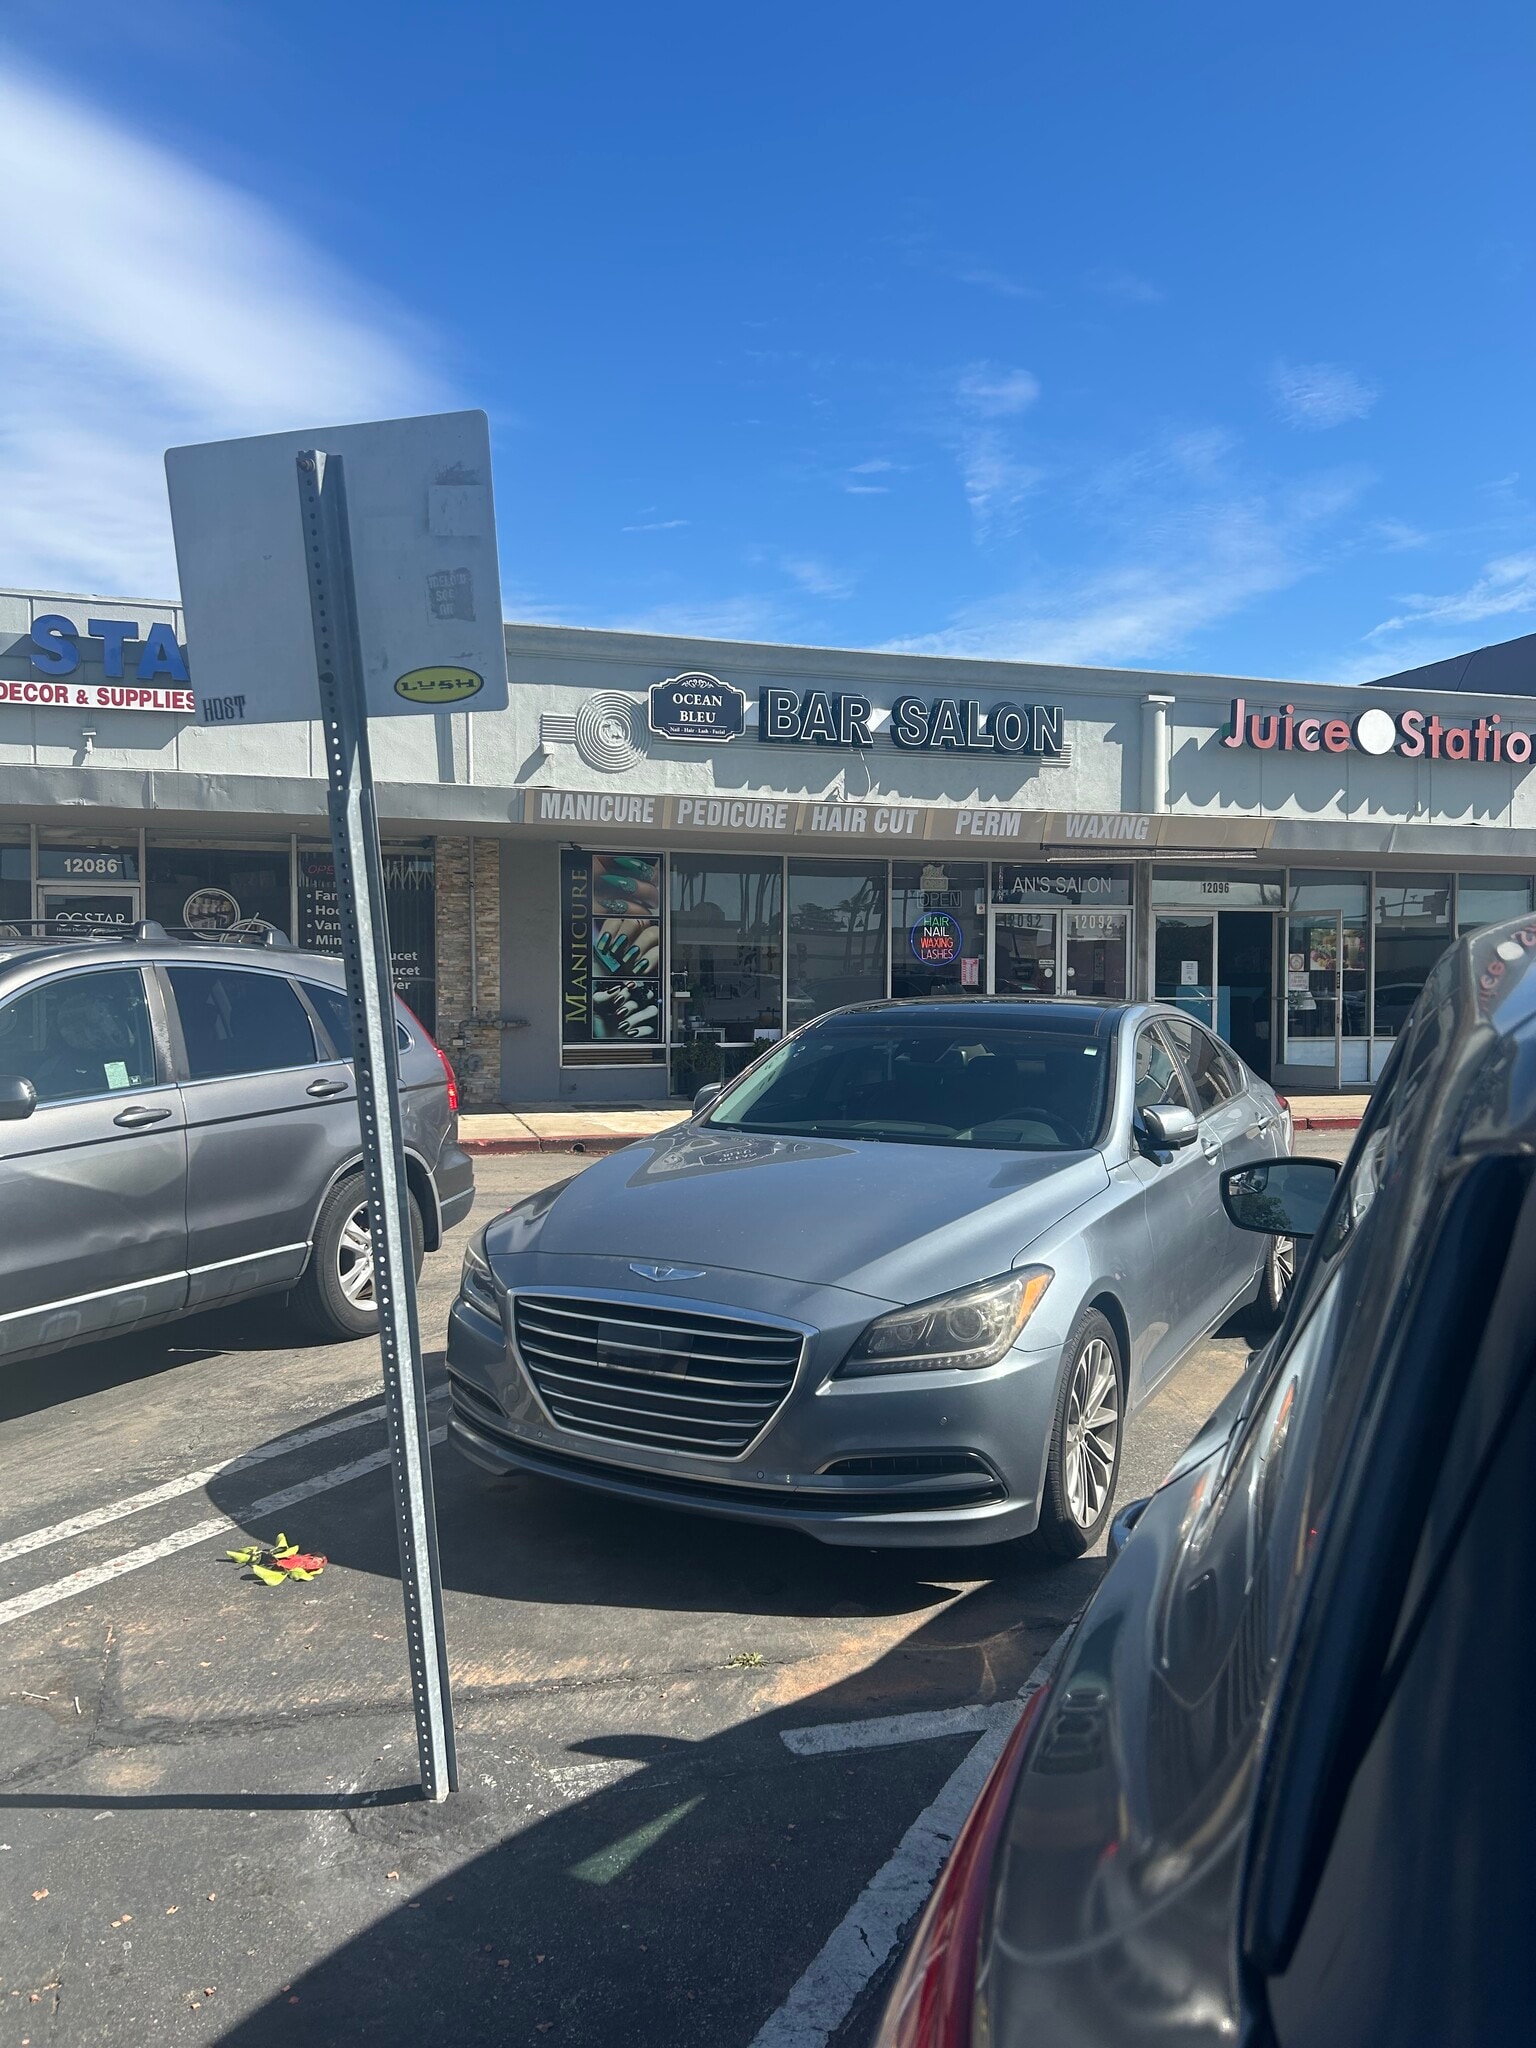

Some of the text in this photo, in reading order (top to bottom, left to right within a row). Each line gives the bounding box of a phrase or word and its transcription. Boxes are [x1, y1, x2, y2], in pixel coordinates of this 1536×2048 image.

[400, 678, 477, 691] LUSH
[0, 682, 196, 710] DECOR & SUPPLIES
[672, 692, 723, 707] OCEAN
[679, 710, 717, 723] BLEU
[760, 686, 1065, 754] BAR SALON
[1221, 698, 1536, 764] Juice Statio
[540, 792, 656, 823] MANICURE
[677, 800, 789, 830] PEDICURE
[811, 805, 919, 834] HAIR CUT
[955, 810, 1022, 837] PERM
[1065, 814, 1150, 840] WAXING
[64, 858, 118, 874] 12086
[1012, 876, 1051, 893] AN'S
[1056, 876, 1112, 894] SALON
[1201, 881, 1230, 894] 12096
[919, 892, 960, 907] OPEN
[314, 919, 341, 931] Van
[923, 916, 950, 926] HAIR
[1074, 915, 1113, 929] 12092
[923, 926, 950, 937] NAIL
[315, 934, 343, 945] Min
[565, 868, 588, 1025] MANICURE
[920, 937, 954, 948] WAXING
[921, 948, 954, 960] LASHES
